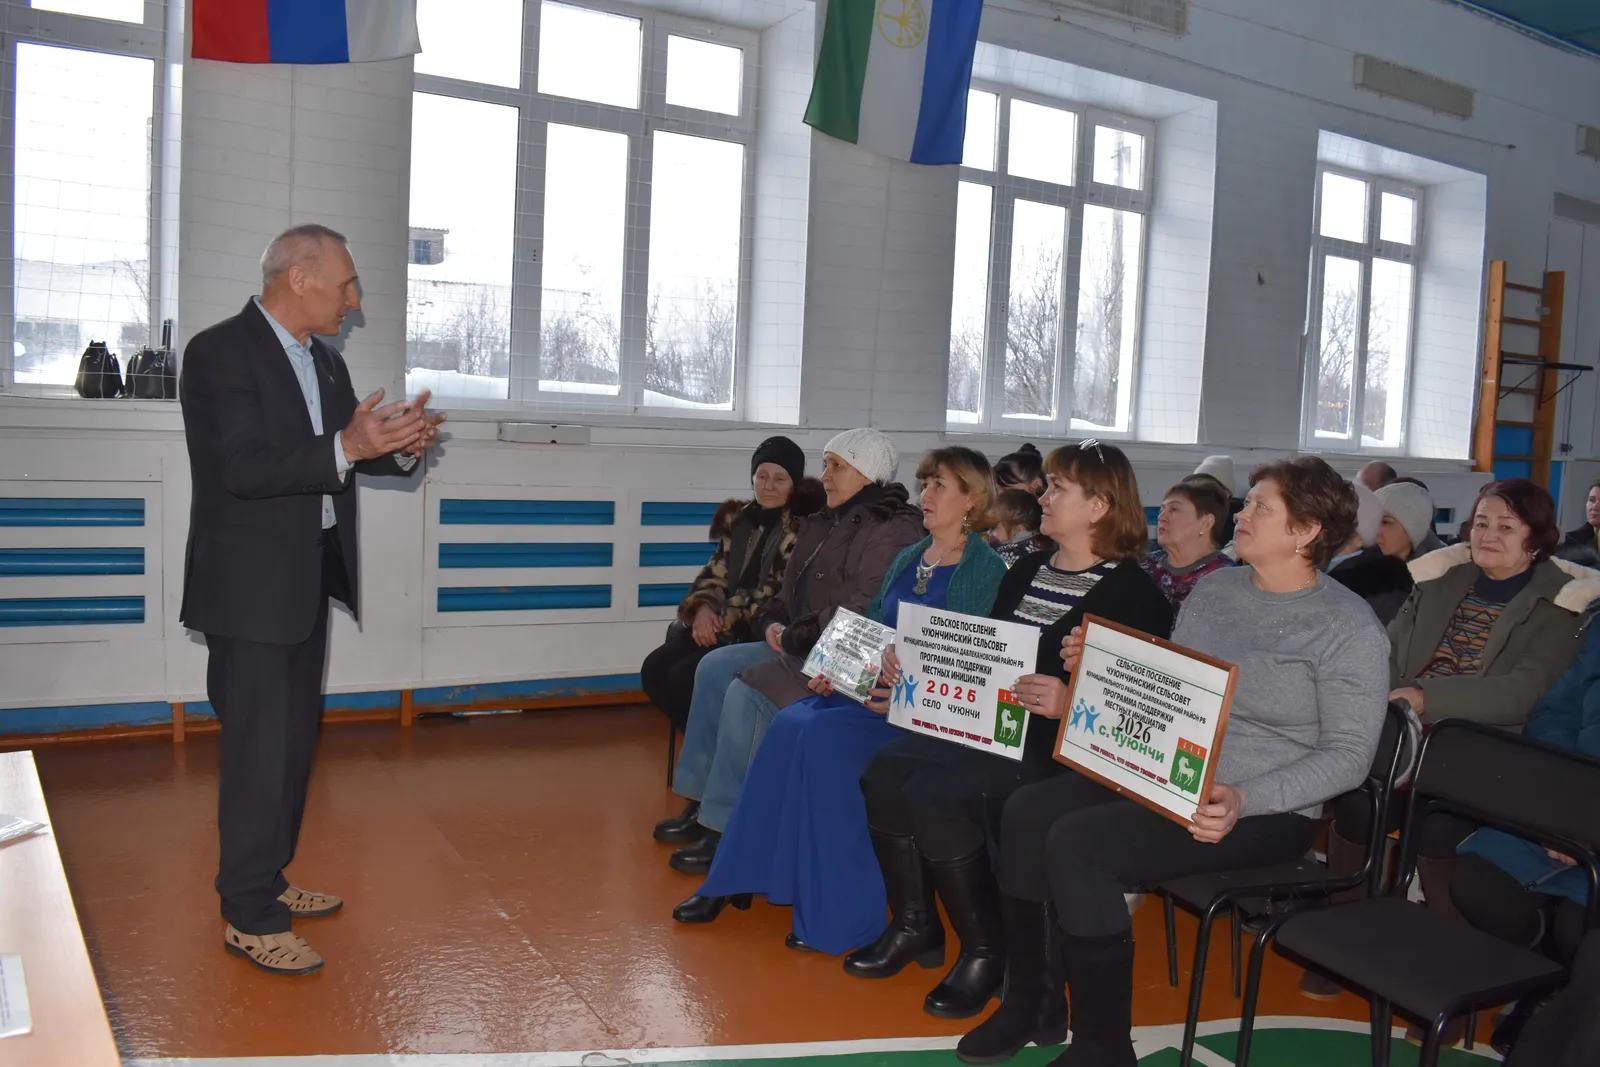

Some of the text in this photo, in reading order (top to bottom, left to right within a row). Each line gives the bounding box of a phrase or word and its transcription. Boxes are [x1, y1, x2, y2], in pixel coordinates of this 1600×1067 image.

[922, 627, 1007, 652] ЧУЮНЧИНСКИЙ СЕЛЬСОВЕТ
[930, 616, 996, 636] СЕЛЬСКОЕ ПОСЕЛЕНИЕ
[904, 636, 940, 650] МУНИЦИПАЛЬНОГО
[941, 644, 959, 654] РАЙОНА
[960, 646, 1001, 662] ДАВЛЕКАНОВСКИЙ
[1001, 656, 1017, 666] РАЙОН
[920, 652, 992, 675] ПРОГРАММА ПОДДЕРЖКИ
[922, 665, 986, 686] МЕСТНЫХ ИНИЦИАТИВ
[1106, 666, 1191, 706] ЧУЮНЧИНСКИЙ СЕЛЬСОВЕТ
[1116, 659, 1181, 690] СЕЛЬСКОЕ ПОСЕЛЕНИЕ
[922, 698, 980, 719] СЕЛО ЧУЮНЧИ
[1086, 670, 1124, 690] МУНИЦИПАЛЬНОГО
[1125, 685, 1142, 697] РАЙОНА
[1142, 692, 1183, 714] ДАВЛЕКАНОВСКИЙ
[1184, 710, 1199, 721] РАЙОН
[1103, 688, 1174, 723] ПРОГРАММА ПОДДЕРЖКИ
[1105, 700, 1166, 732] МЕСТНЫХ ИНИЦИАТИВ
[1116, 714, 1151, 743] 2026
